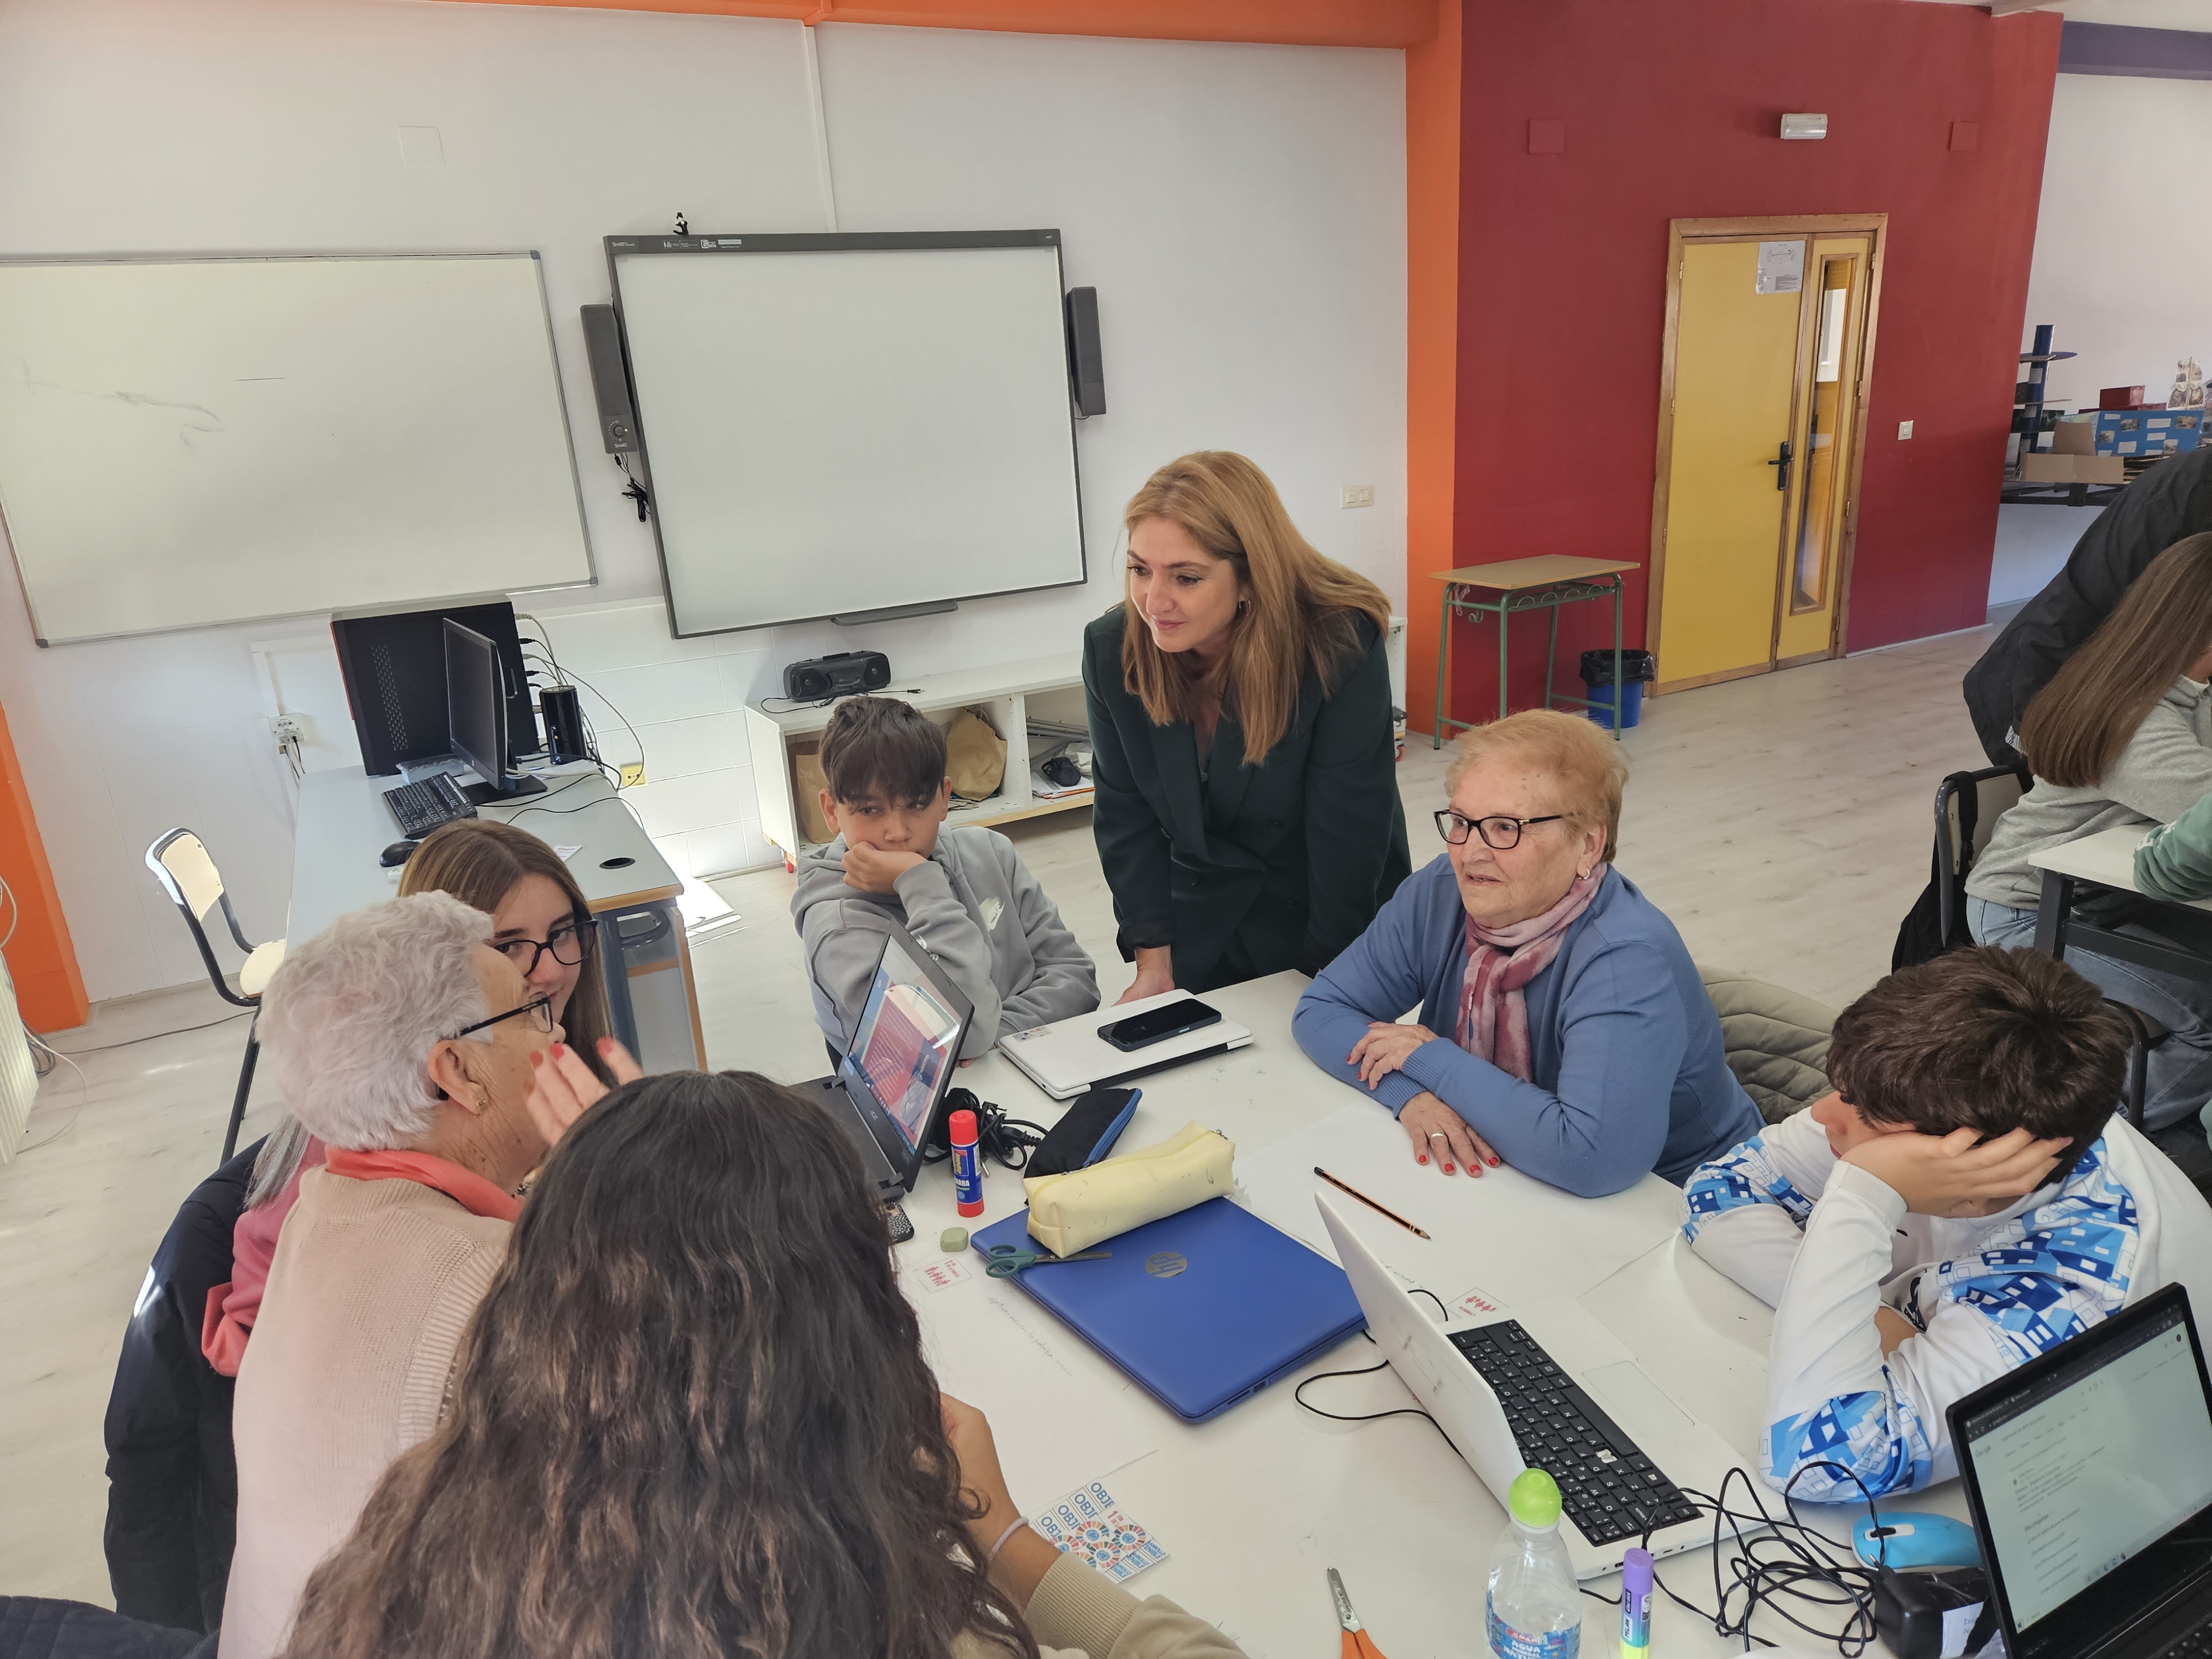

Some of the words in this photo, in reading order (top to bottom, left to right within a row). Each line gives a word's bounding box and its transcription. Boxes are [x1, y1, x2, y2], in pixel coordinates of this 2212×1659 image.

[1146, 1252, 1187, 1277] hp
[1511, 1632, 1537, 1644] SPAR
[1511, 1640, 1541, 1653] AQUA
